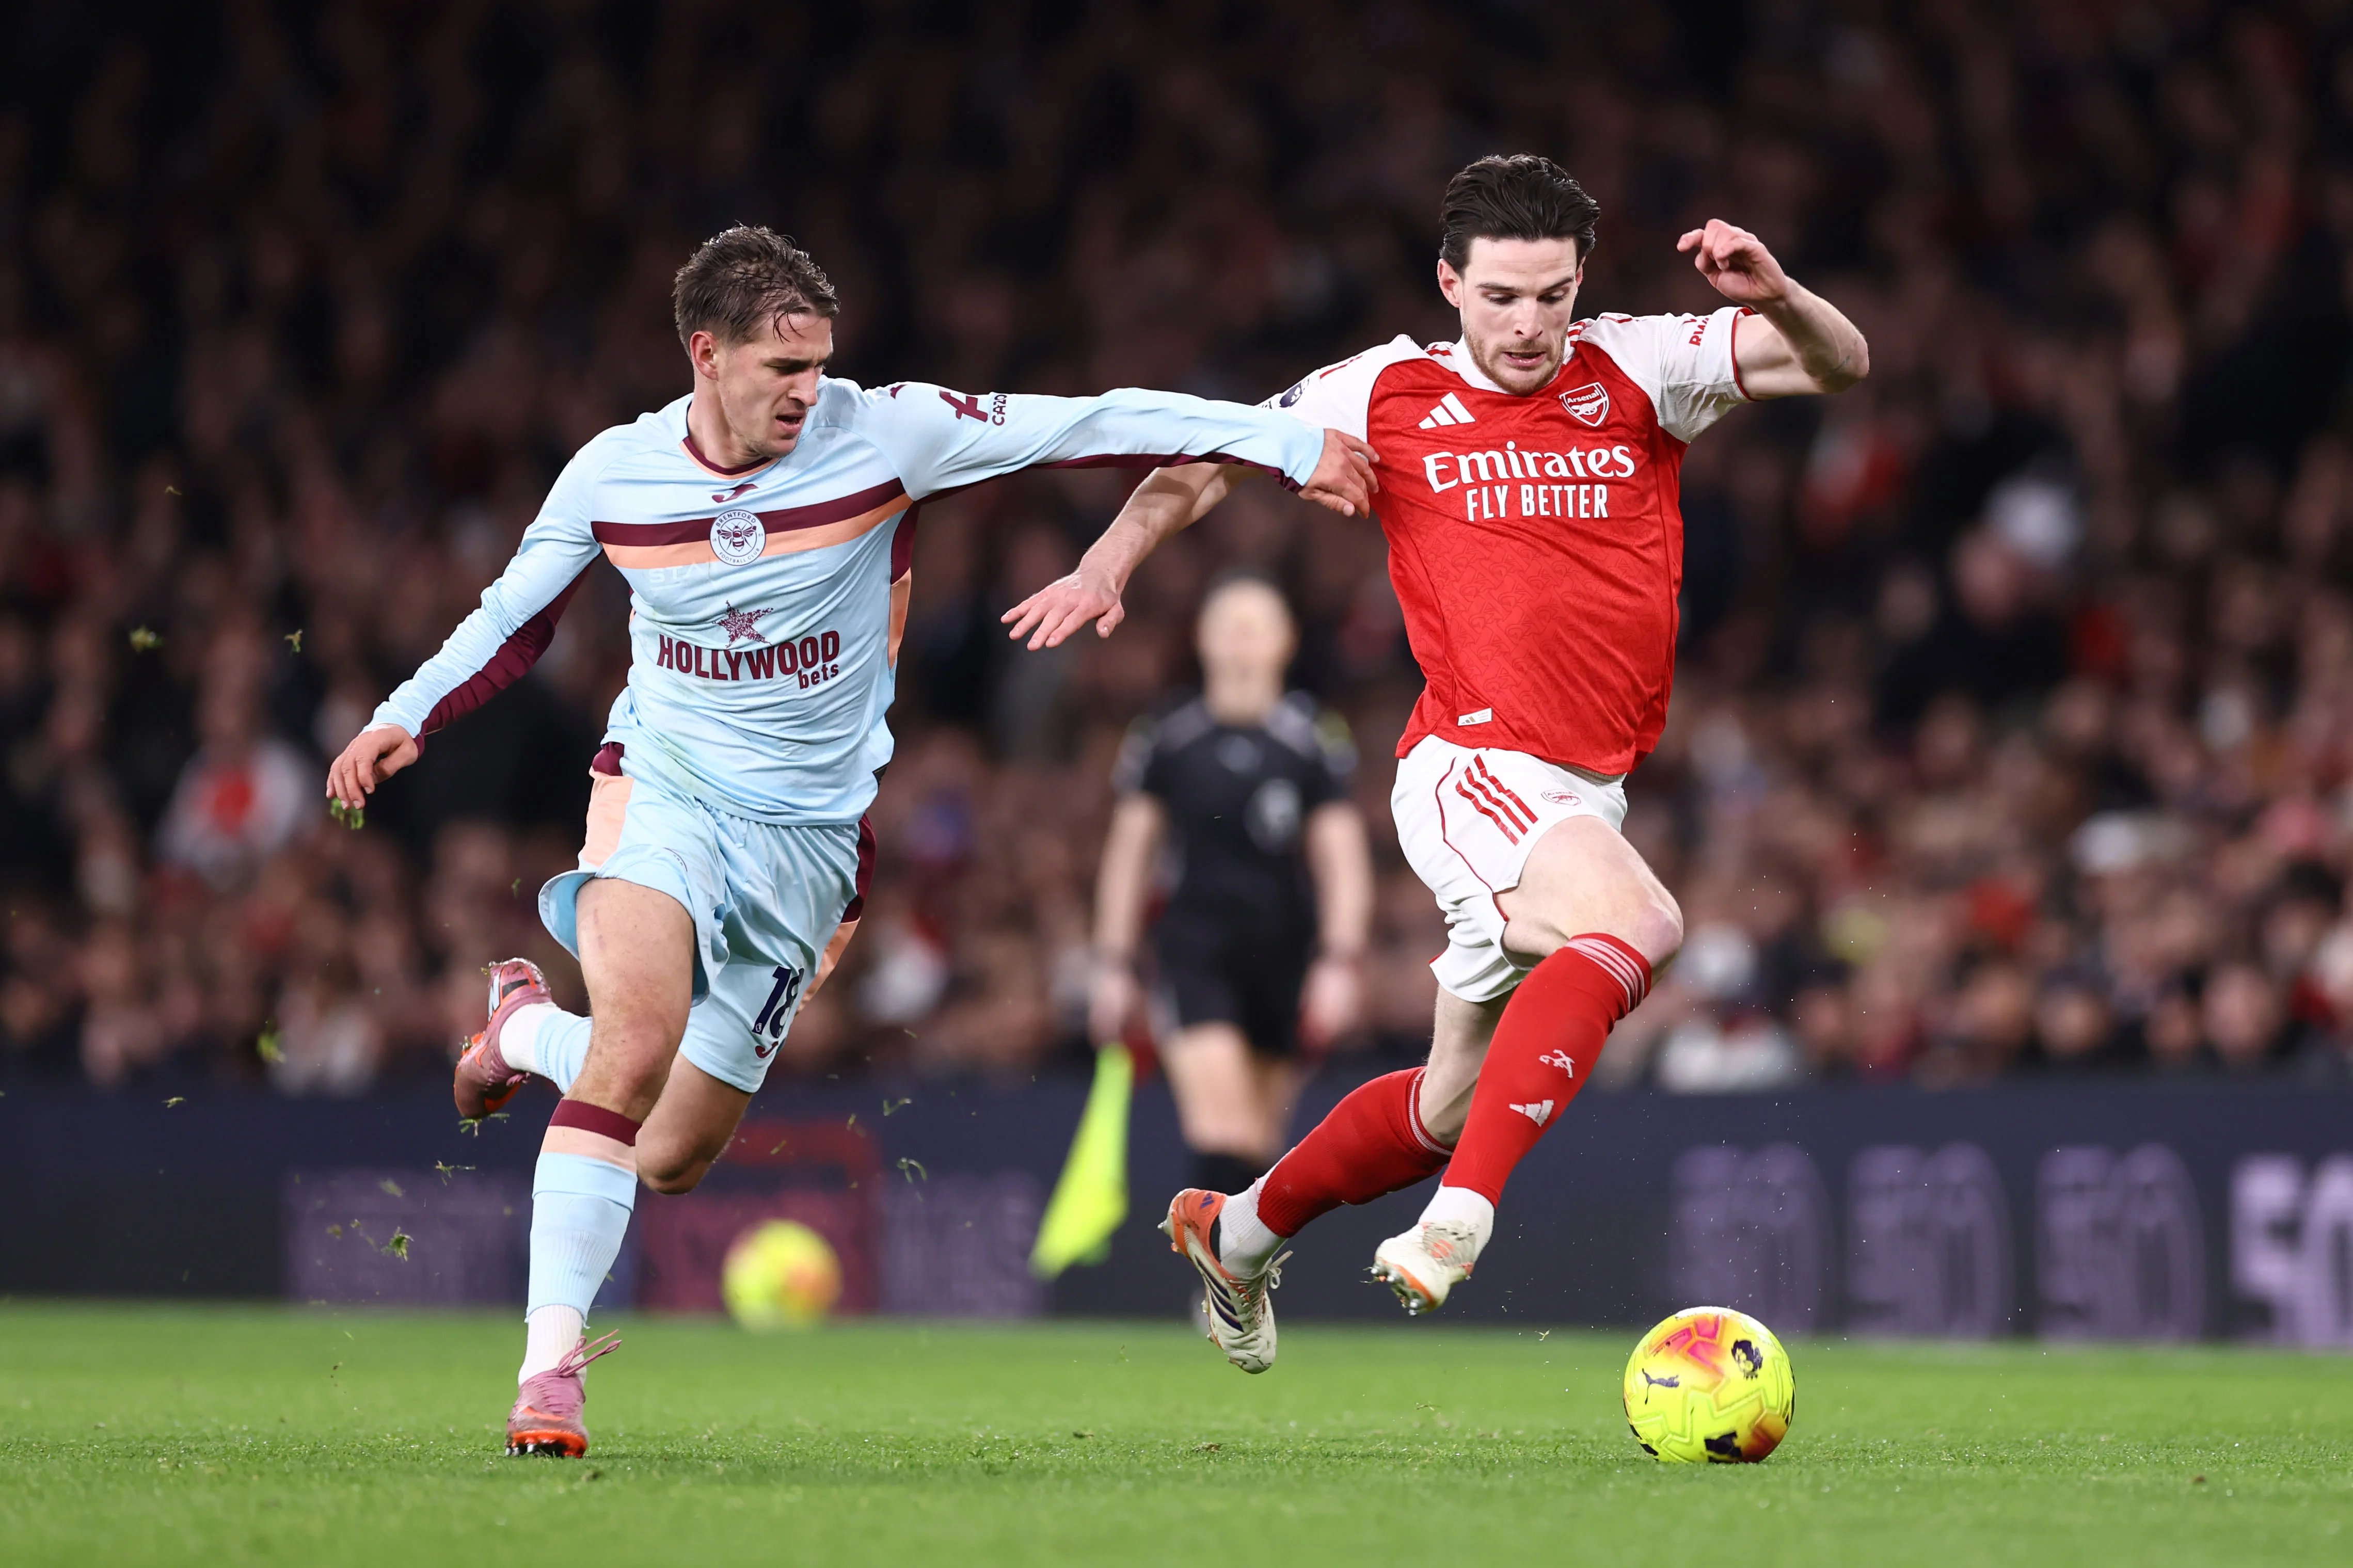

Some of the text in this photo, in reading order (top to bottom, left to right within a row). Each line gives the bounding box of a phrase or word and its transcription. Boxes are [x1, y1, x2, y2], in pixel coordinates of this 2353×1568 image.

[1567, 390, 1599, 403] Arsenal
[1422, 441, 1635, 493] Emirates
[1466, 484, 1608, 521] FLY BETTER
[716, 512, 756, 527] BRENTFORD
[719, 548, 760, 563] FOOTBALL CLUB
[657, 631, 839, 681] HOLLYWOOD
[798, 664, 839, 690] bets
[752, 965, 804, 1038] 18
